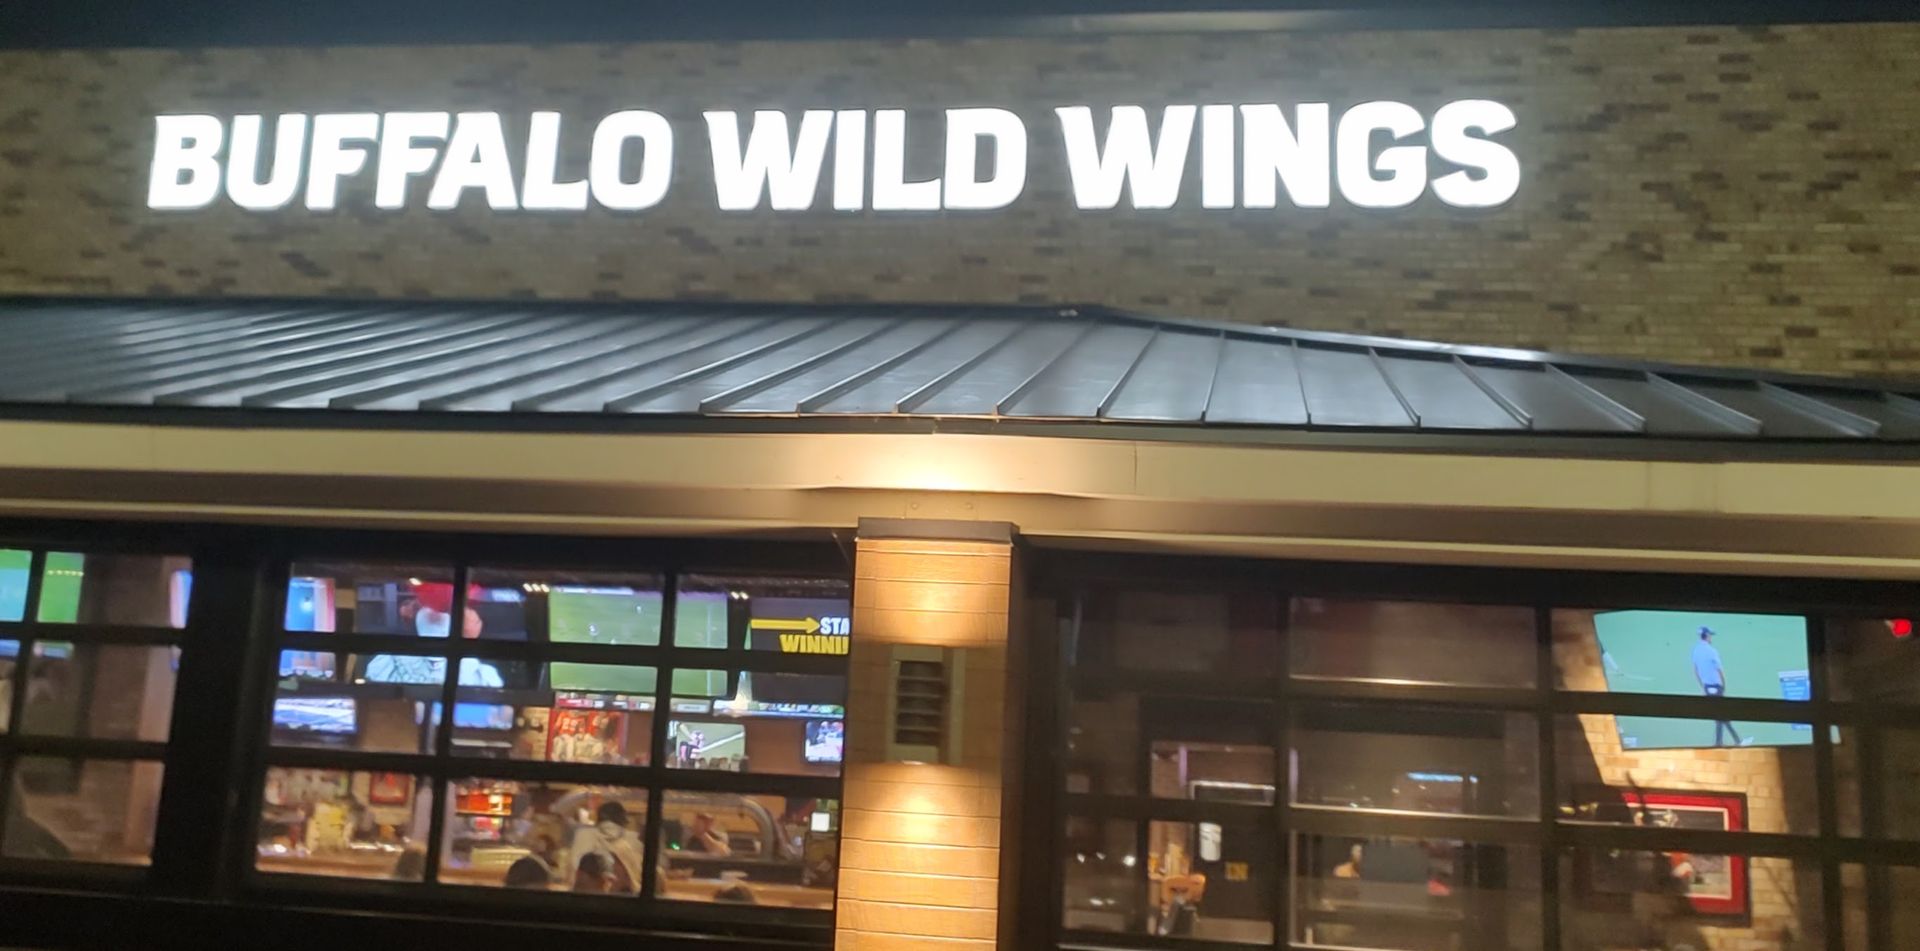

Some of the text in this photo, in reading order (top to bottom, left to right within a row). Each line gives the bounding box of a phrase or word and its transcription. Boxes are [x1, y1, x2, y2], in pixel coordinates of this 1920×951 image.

[148, 100, 1521, 211] BUFFALO WILD WINGS
